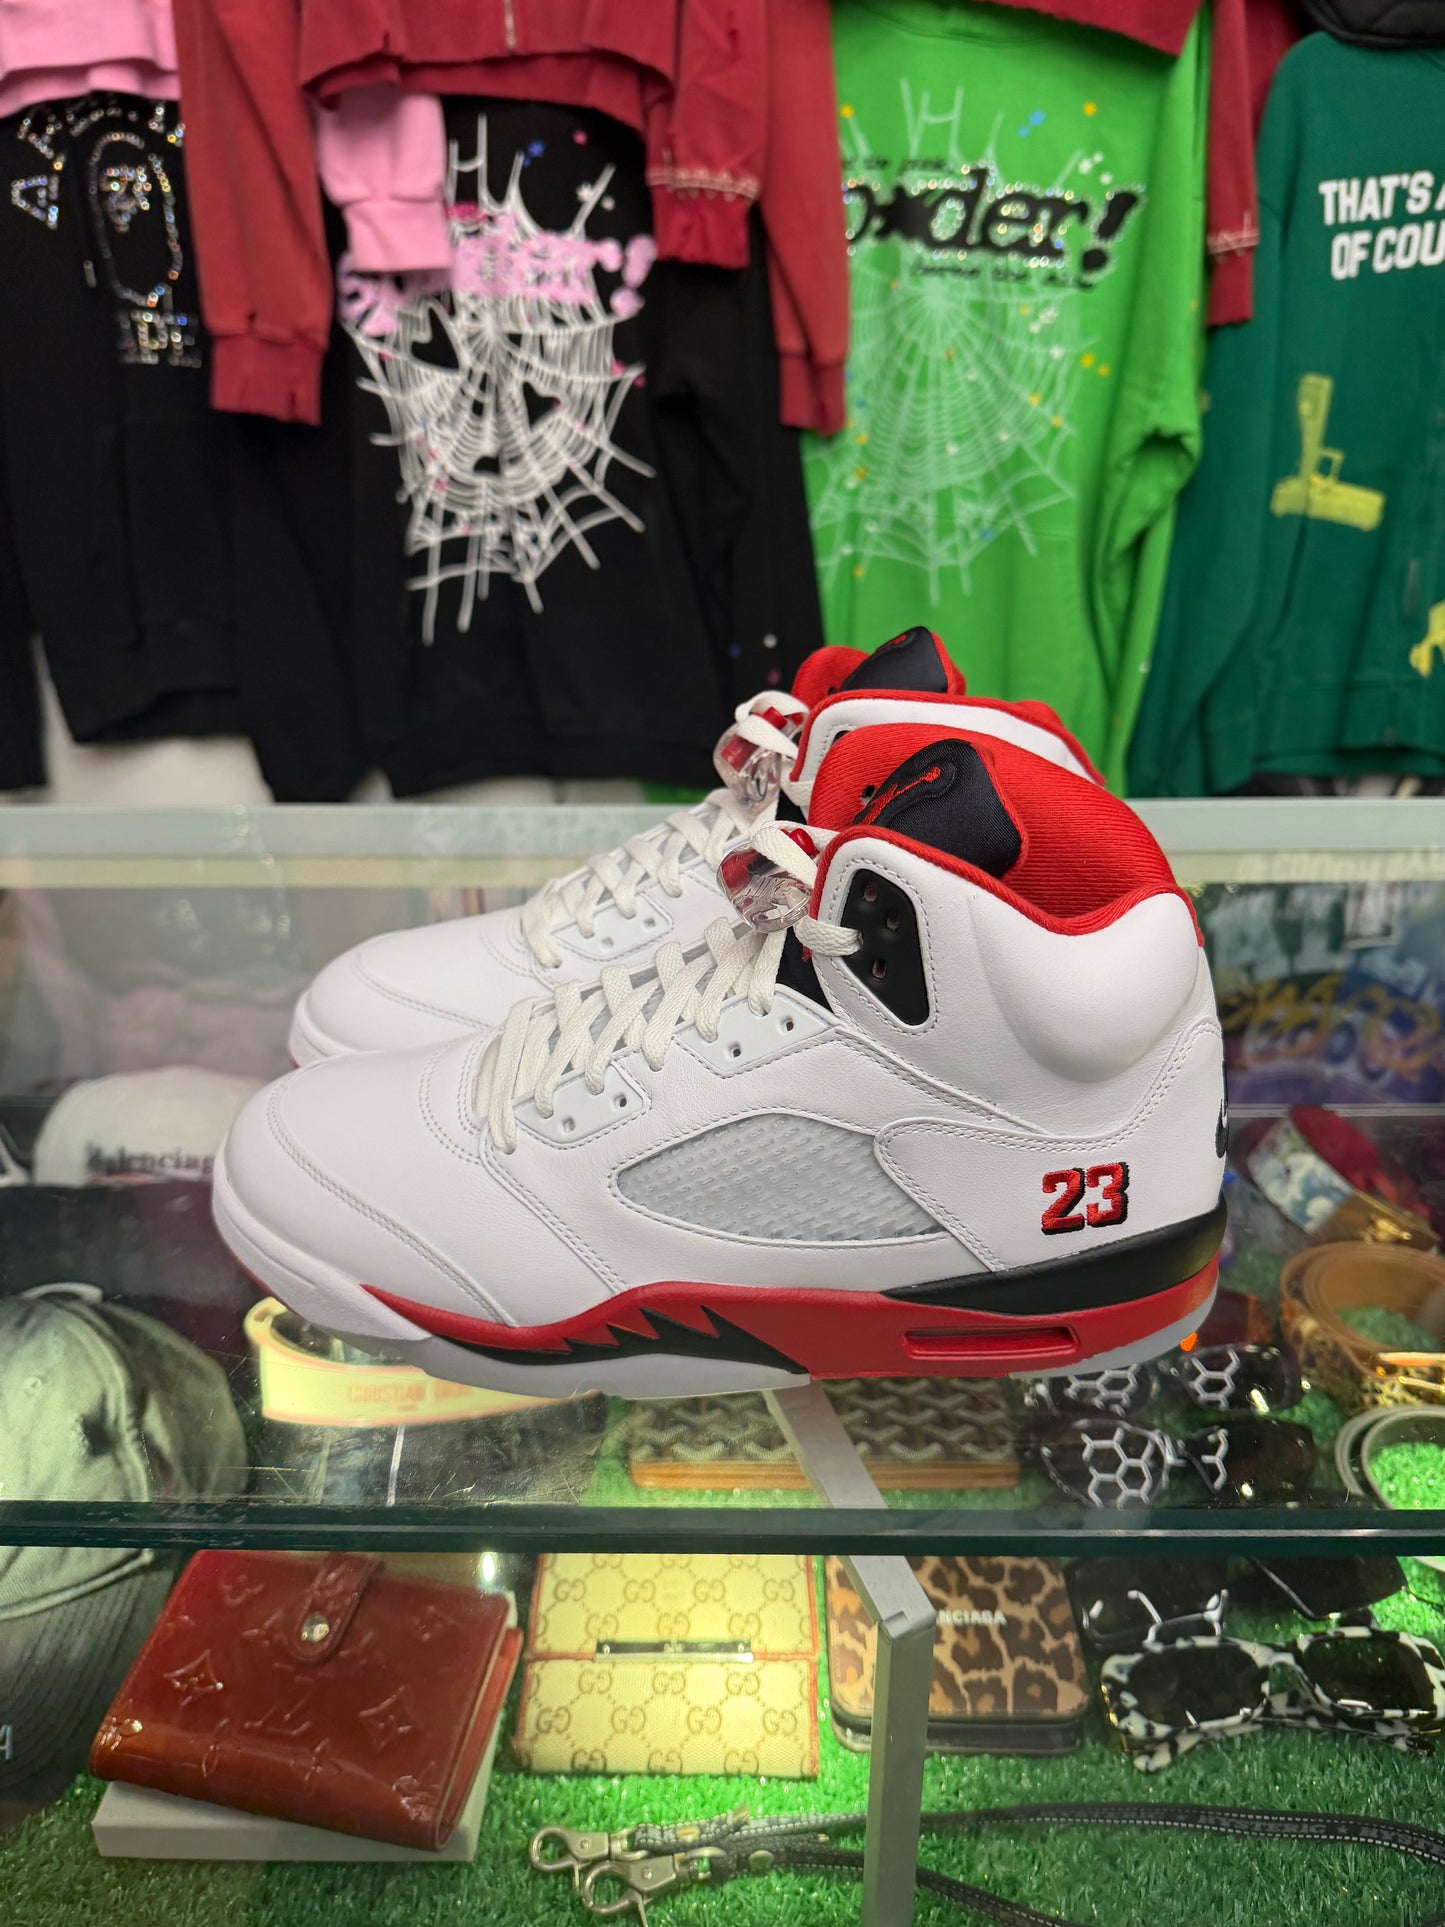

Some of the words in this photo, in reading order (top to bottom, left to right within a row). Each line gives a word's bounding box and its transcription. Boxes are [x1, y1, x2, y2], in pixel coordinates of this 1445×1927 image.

[1318, 170, 1434, 226] THAT'S
[1330, 231, 1372, 280] OF
[1041, 1162, 1129, 1235] 23
